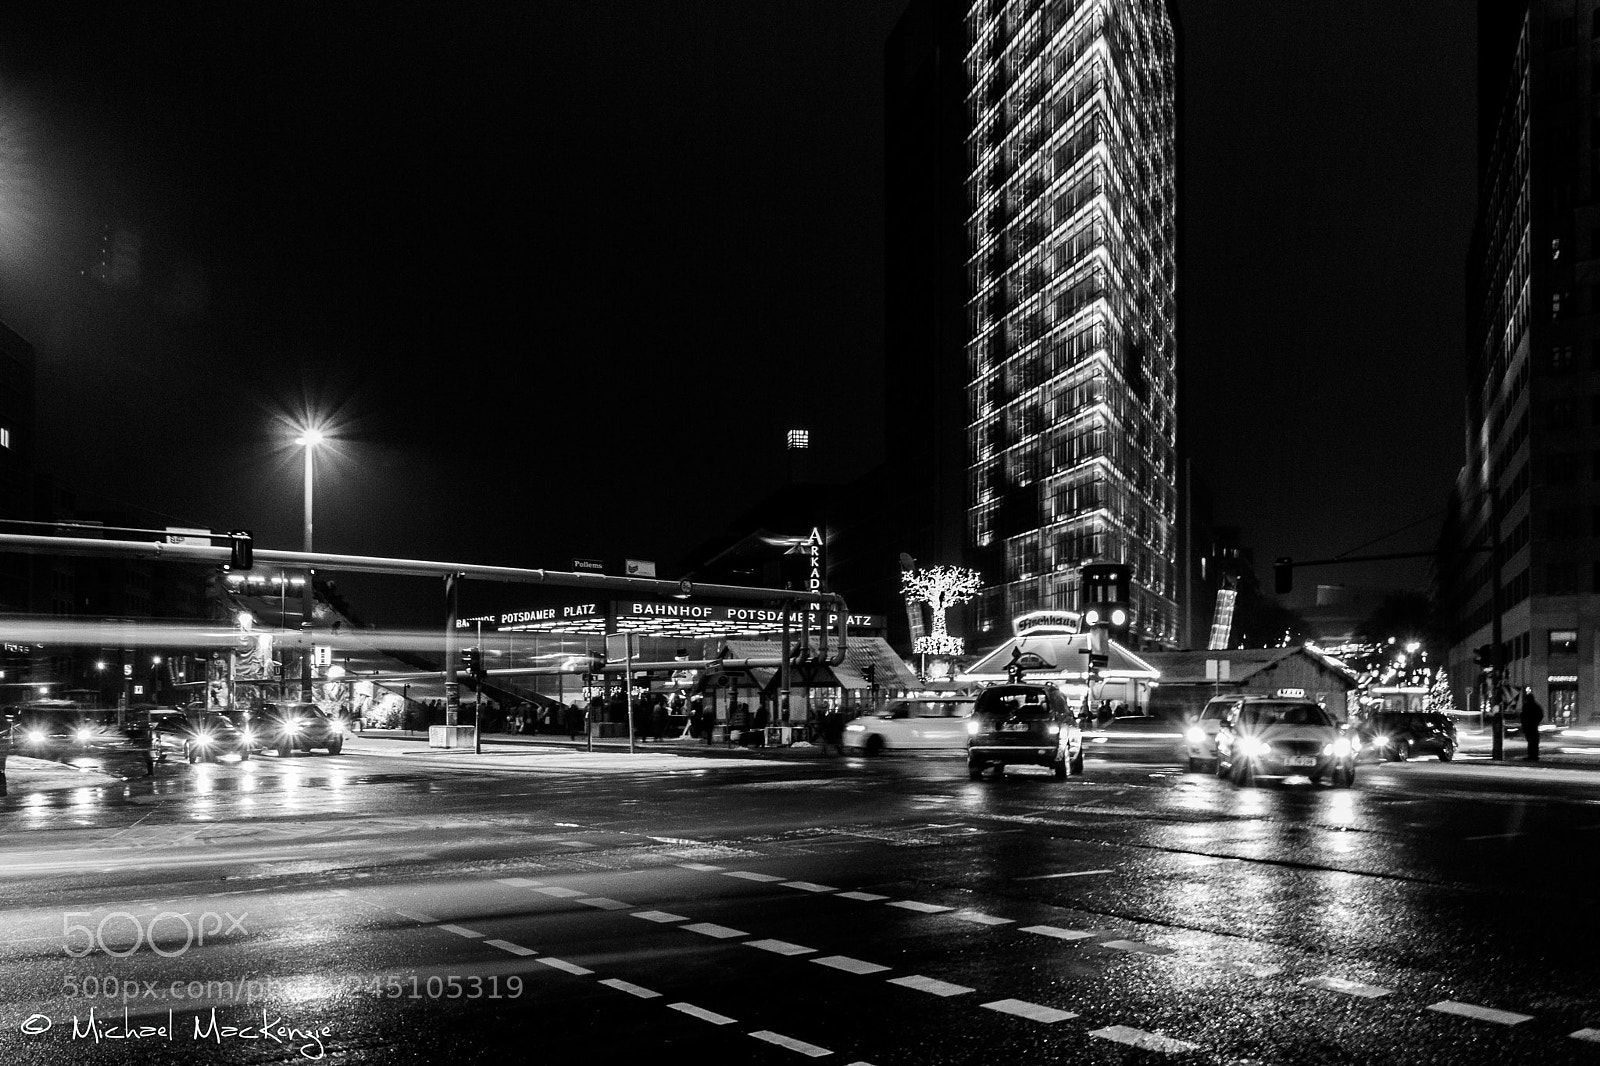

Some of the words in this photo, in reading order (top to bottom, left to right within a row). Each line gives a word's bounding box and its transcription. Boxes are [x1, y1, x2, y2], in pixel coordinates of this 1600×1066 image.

[501, 609, 556, 624] POTSDAMER
[563, 604, 596, 617] PLATZ
[632, 603, 712, 617] BAHNHOF
[727, 609, 816, 623] POTSDAMER
[829, 614, 872, 626] PATZ
